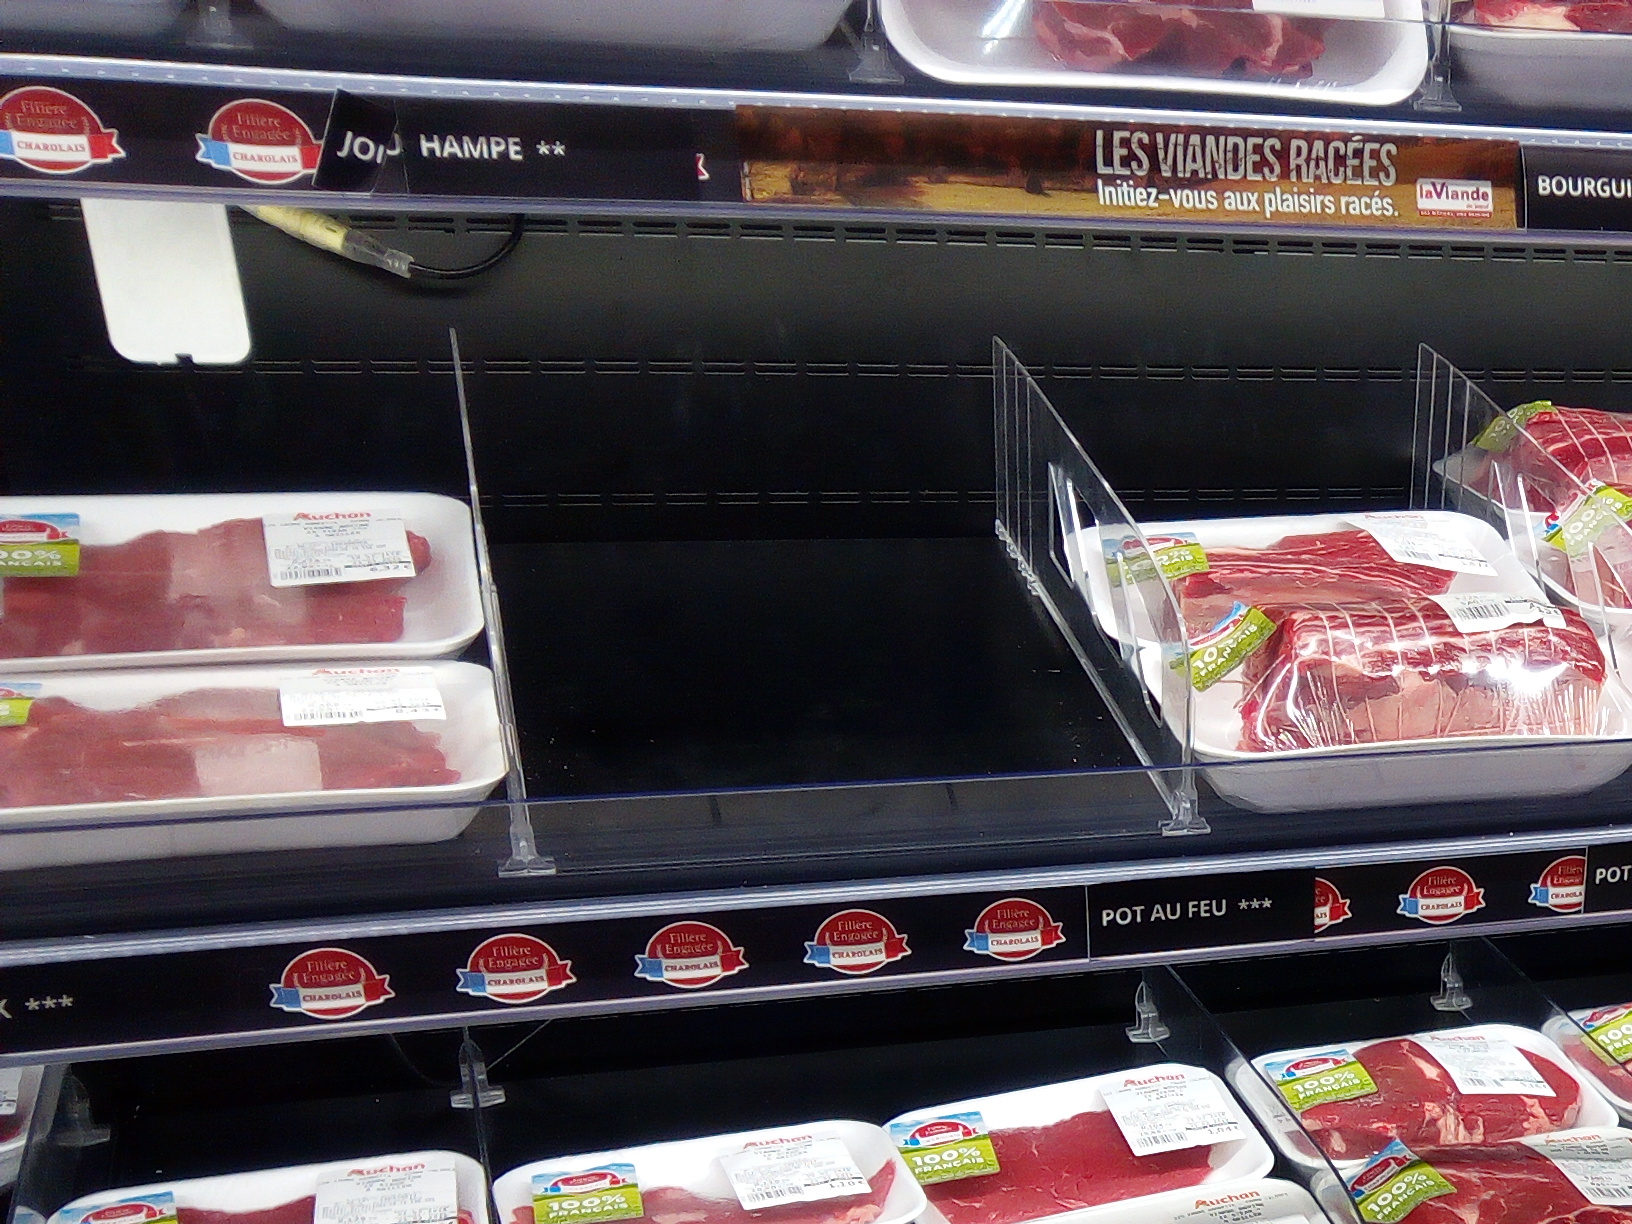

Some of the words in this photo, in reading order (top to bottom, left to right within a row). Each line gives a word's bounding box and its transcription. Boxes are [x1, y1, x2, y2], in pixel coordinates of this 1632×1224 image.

[16, 140, 86, 153] CHAROLAIS
[420, 134, 522, 161] HAMPE
[233, 151, 298, 164] CHAROLAIS
[1096, 130, 1148, 176] LES
[1156, 133, 1279, 182] VIANDES
[1289, 136, 1398, 186] RACÉES
[1097, 180, 1217, 210] Initiez-vous
[1223, 189, 1258, 211] aux
[1264, 187, 1335, 218] plaisirs
[1340, 191, 1398, 217] racés.
[293, 512, 371, 521] Auchan
[1595, 866, 1631, 885] POT
[1550, 891, 1583, 900] CHAROLA
[1102, 906, 1143, 927] POT
[1150, 904, 1181, 922] AU
[1188, 900, 1226, 918] FEU
[837, 919, 873, 932] Filière
[990, 935, 1039, 946] CHAROLAIS
[832, 948, 883, 960] CHAROLAIS
[307, 960, 348, 973] Filière
[664, 961, 719, 972] CHAROLAIS
[487, 975, 546, 986] CHAROLAIS
[302, 990, 363, 1002] CHAROLAIS
[1123, 1073, 1186, 1088] Auchan
[1293, 1070, 1355, 1094] 100%
[1298, 1078, 1361, 1099] FRANÇAIS
[743, 1134, 813, 1149] Auchan
[1544, 1133, 1602, 1144] Auchan
[911, 1147, 981, 1167] 100%
[347, 1163, 426, 1177] Auchan
[914, 1156, 985, 1174] FRANÇAIS
[1194, 1190, 1261, 1209] Auchan
[1366, 1172, 1428, 1213] 100%
[548, 1193, 626, 1212] 100%
[1374, 1179, 1437, 1223] FRANÇAIS
[549, 1203, 628, 1219] FRANÇAIS
